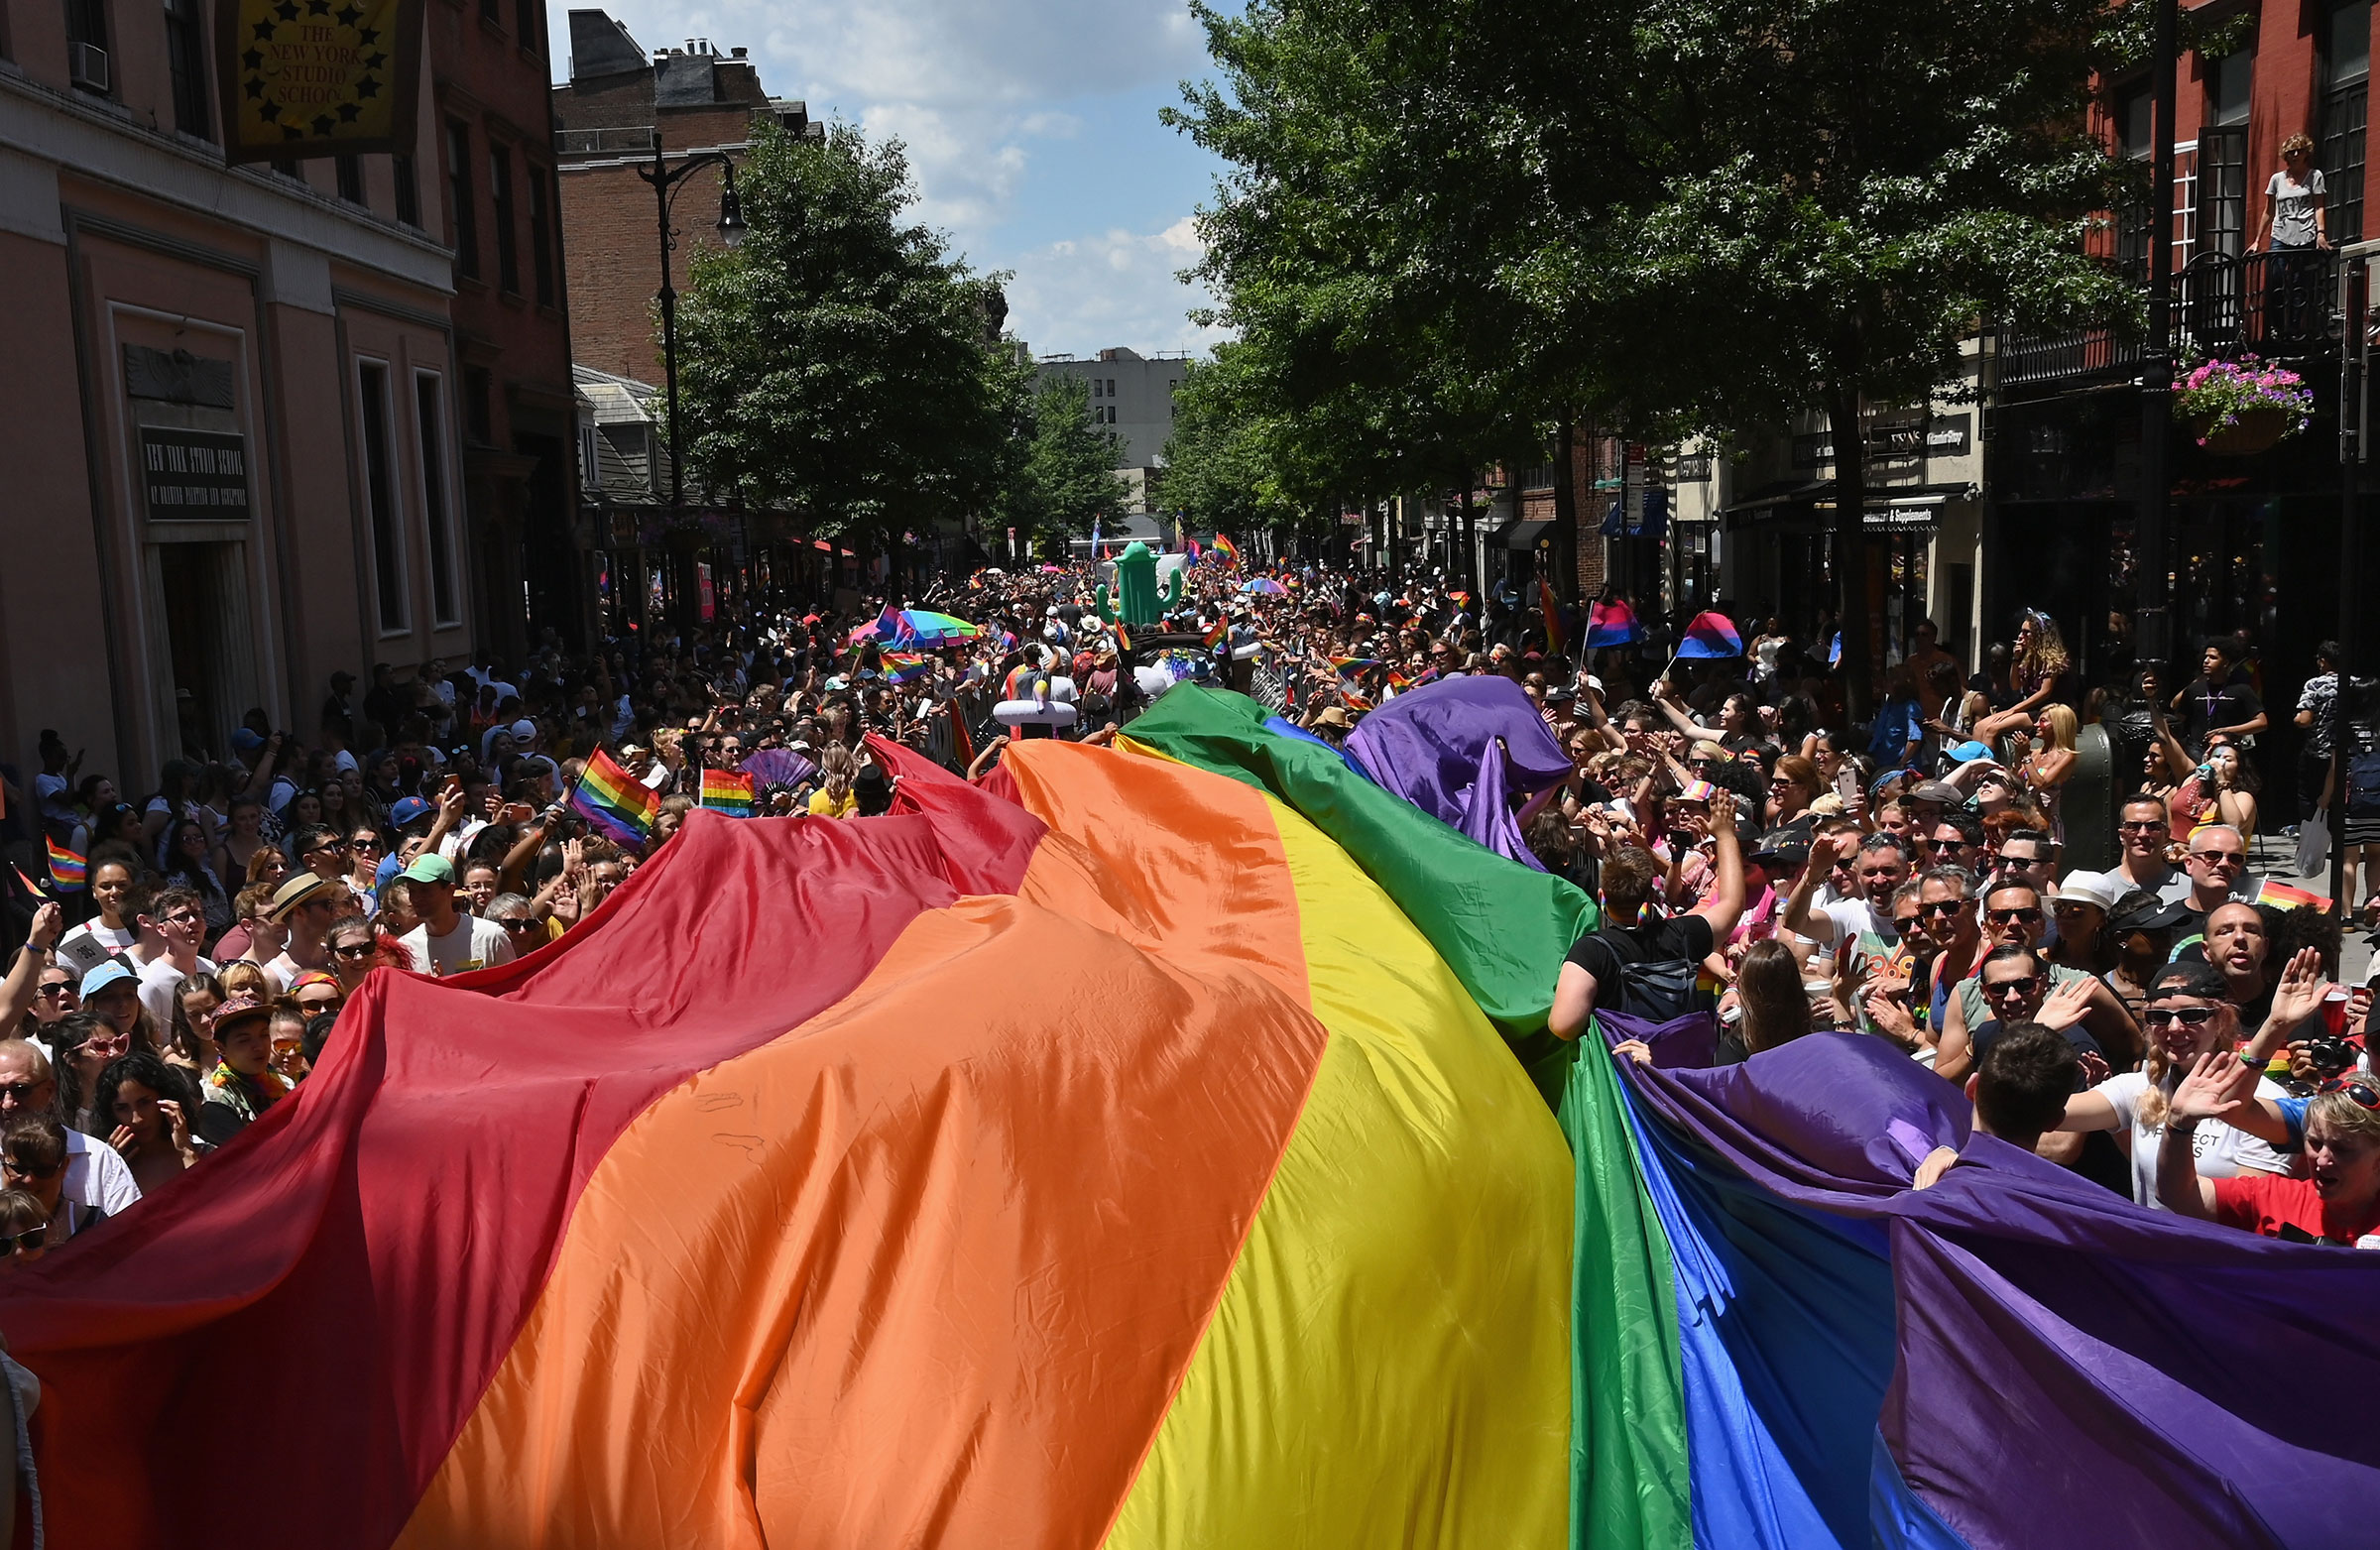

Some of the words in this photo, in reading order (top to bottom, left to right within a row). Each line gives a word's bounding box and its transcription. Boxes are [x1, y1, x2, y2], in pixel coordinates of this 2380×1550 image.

[300, 26, 334, 42] THE
[270, 44, 308, 61] NEW
[314, 46, 364, 64] YORK
[282, 65, 346, 84] STUDIO
[1895, 508, 1933, 525] Supplements
[2153, 1127, 2220, 1146] PECT
